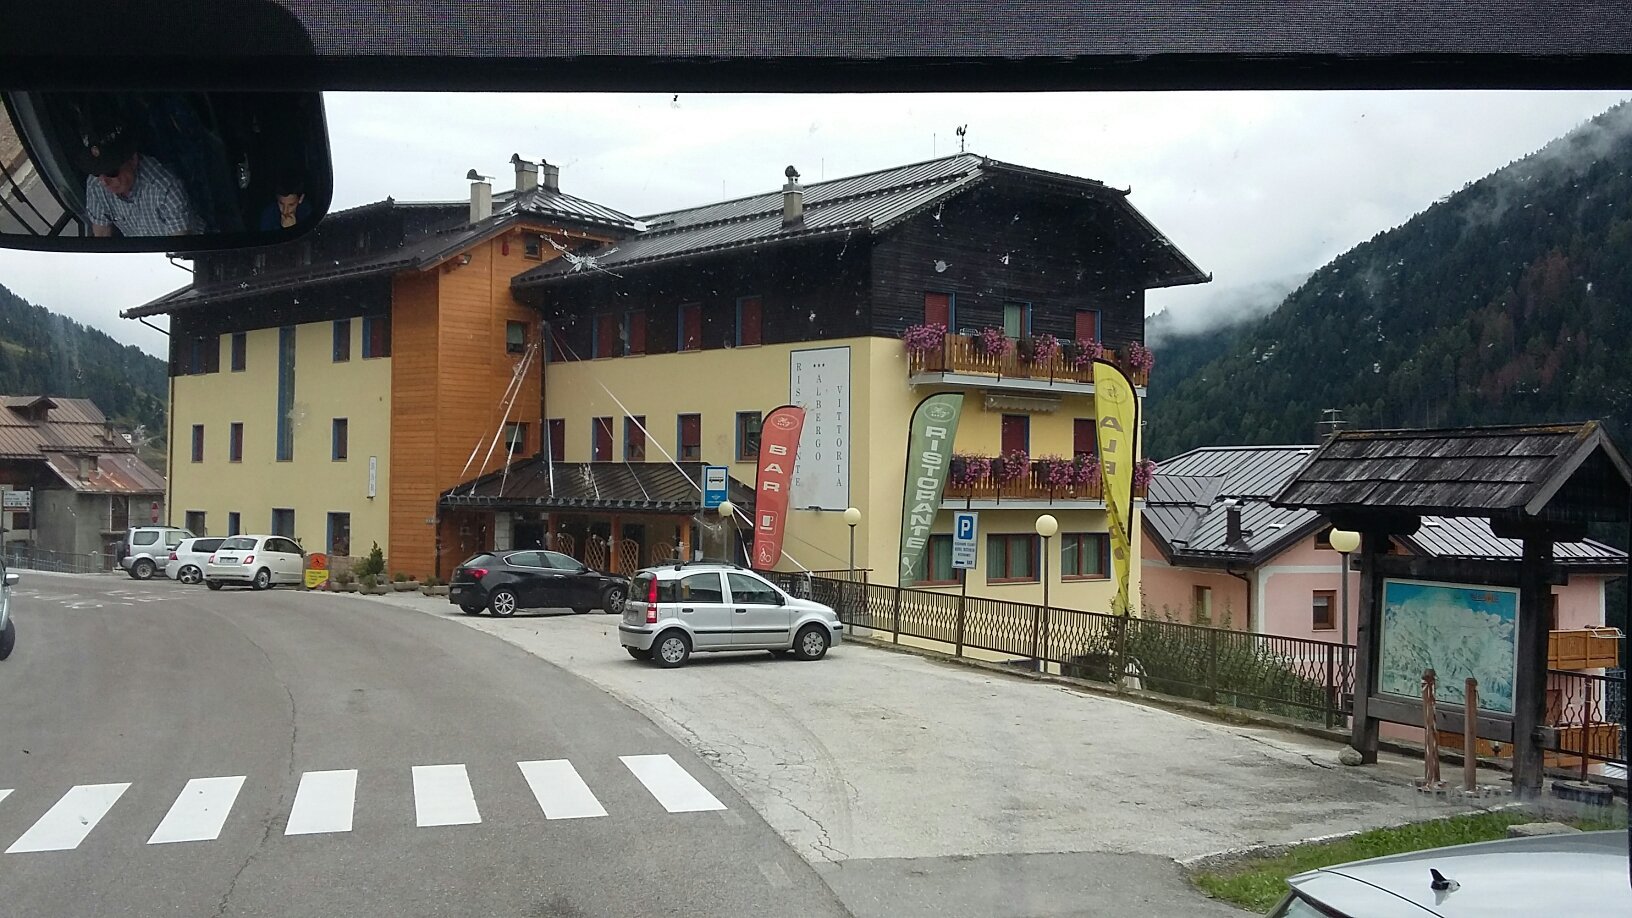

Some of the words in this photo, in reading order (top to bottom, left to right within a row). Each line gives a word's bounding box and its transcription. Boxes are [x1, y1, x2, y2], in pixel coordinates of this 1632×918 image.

[762, 444, 787, 493] BAR
[905, 425, 947, 550] RISTORANTE
[961, 519, 971, 537] P
